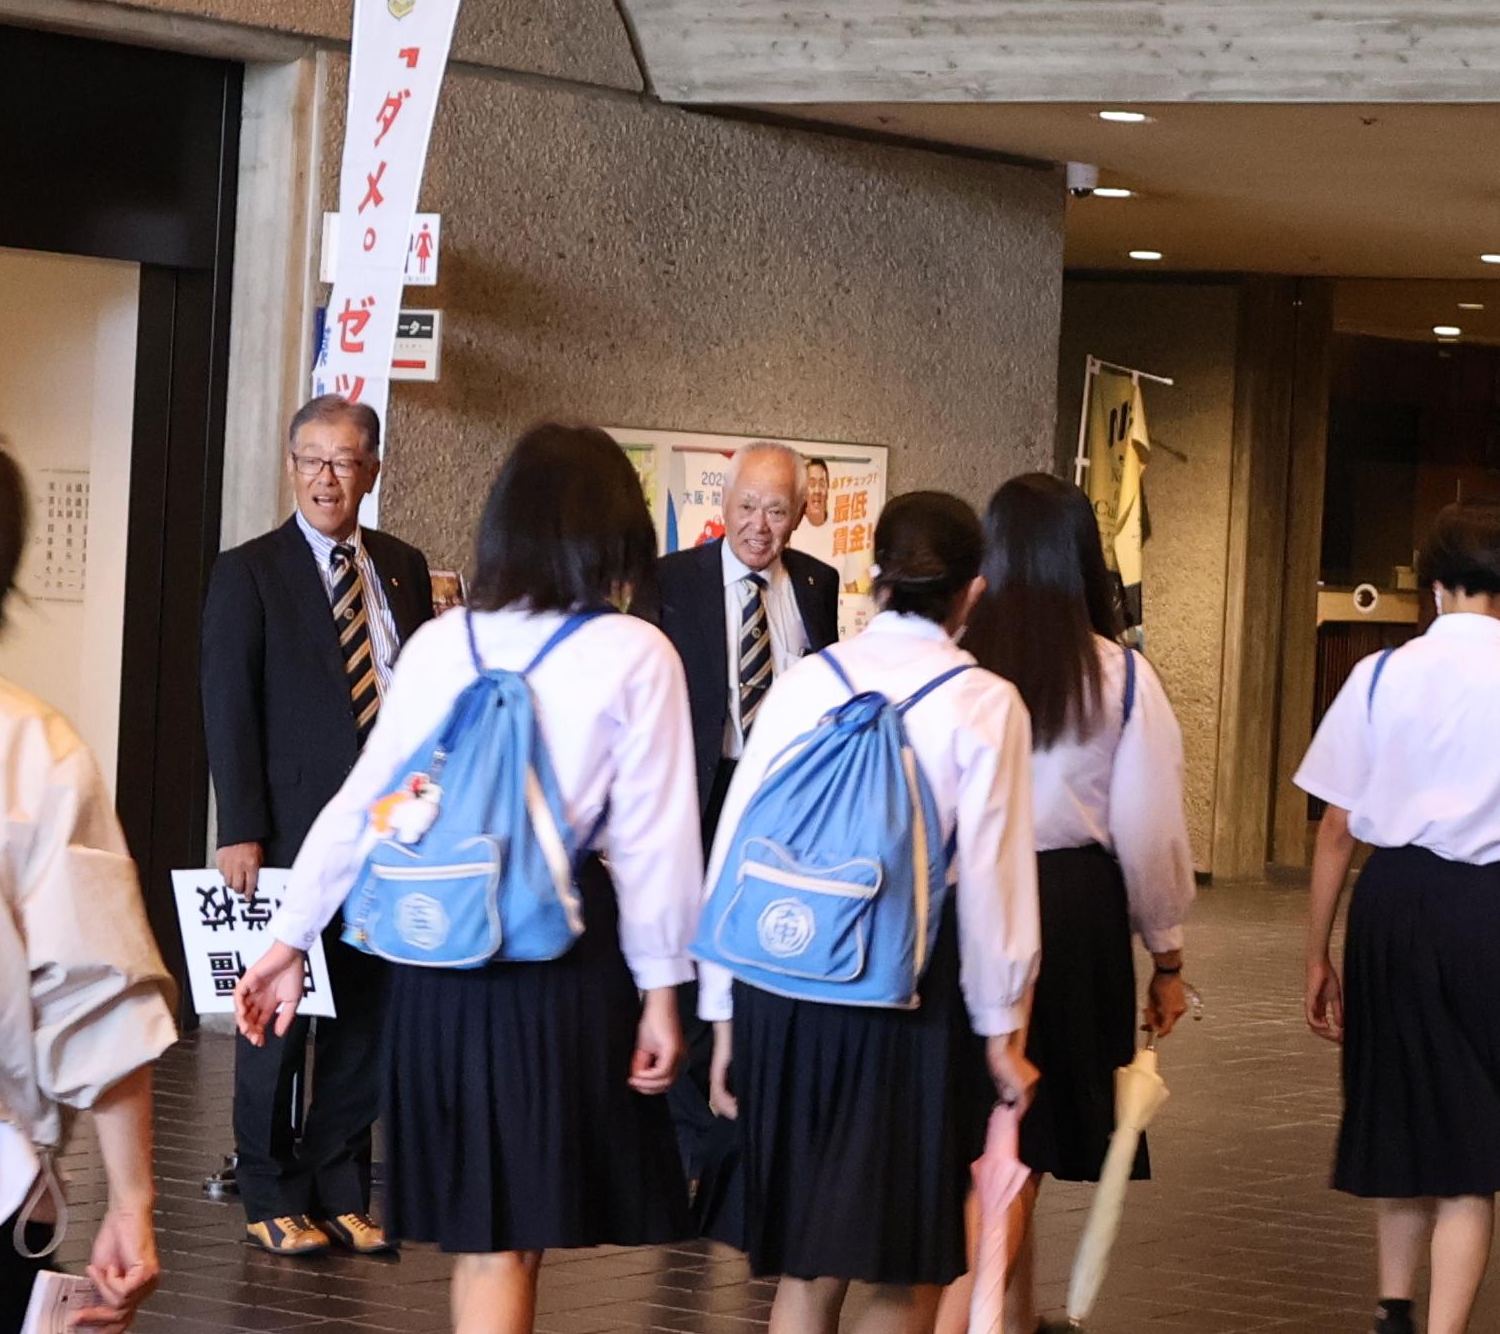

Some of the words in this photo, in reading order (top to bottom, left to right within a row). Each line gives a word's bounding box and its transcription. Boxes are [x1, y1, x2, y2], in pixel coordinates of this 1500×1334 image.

[701, 471, 728, 487] 202
[833, 490, 868, 524] 最低
[196, 885, 287, 933] 学校
